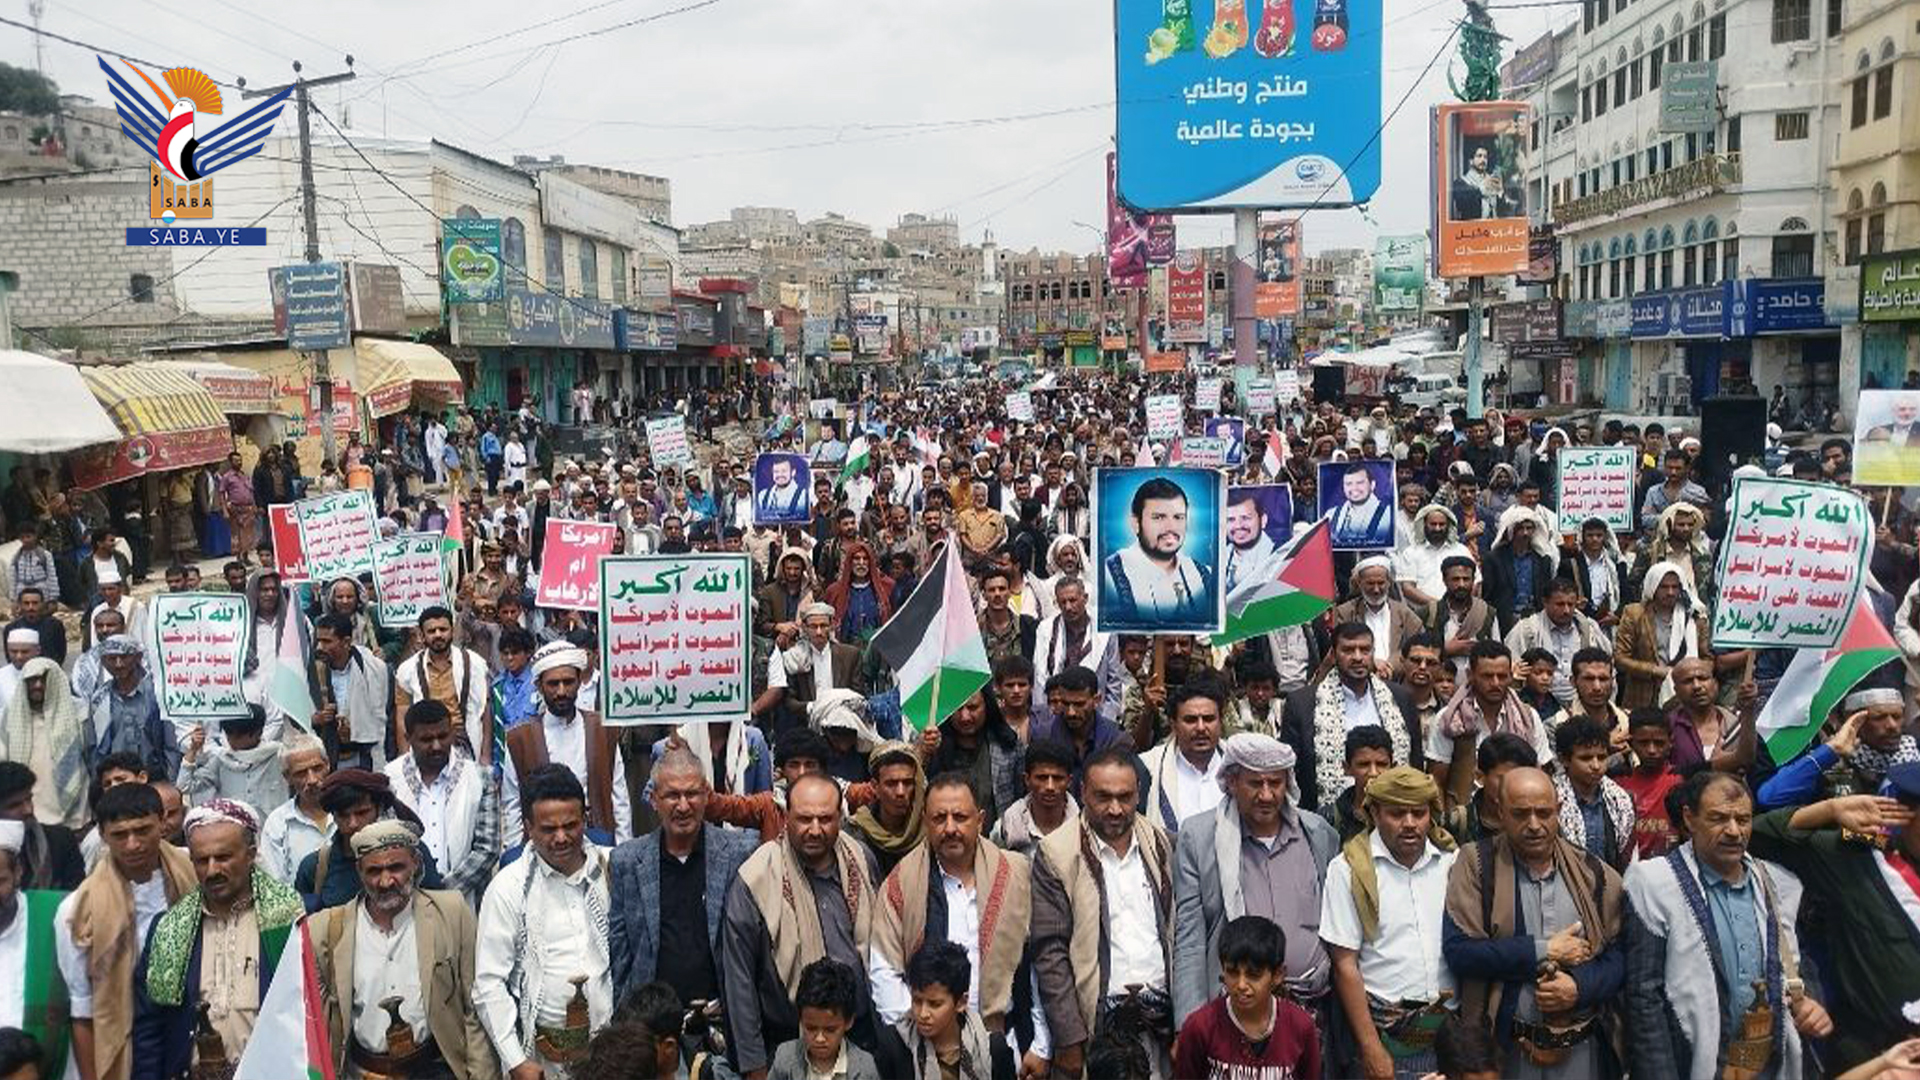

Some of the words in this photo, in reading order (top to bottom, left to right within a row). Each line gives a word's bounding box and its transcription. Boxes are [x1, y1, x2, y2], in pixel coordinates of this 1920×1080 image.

[1182, 76, 1247, 104] وطني
[1255, 75, 1308, 104] منتج
[1176, 119, 1243, 145] عالمية
[1250, 118, 1315, 144] بجودة
[1768, 289, 1812, 308] حامد
[1604, 452, 1630, 467] الله
[342, 495, 366, 509] الله
[1741, 490, 1812, 524] أكبر
[1814, 495, 1862, 524] الله
[414, 539, 439, 554] الله
[1803, 534, 1859, 555] الموت
[609, 564, 690, 604] أكبر
[693, 564, 742, 593] الله
[1798, 564, 1854, 584] الموت
[1723, 584, 1768, 605] اليهود
[1771, 587, 1799, 608] على
[1805, 590, 1848, 610] اللعنة
[208, 601, 243, 622] الله
[610, 599, 679, 627] لأمريكا
[685, 602, 741, 626] الموت
[1778, 612, 1841, 641] النصر
[610, 630, 680, 656] لإسرائيل
[685, 631, 741, 653] الموت
[610, 660, 660, 682] اليهود
[664, 660, 693, 681] على
[699, 657, 741, 676] اللعنة
[611, 683, 678, 713] للإسلام
[683, 680, 741, 710] النصر
